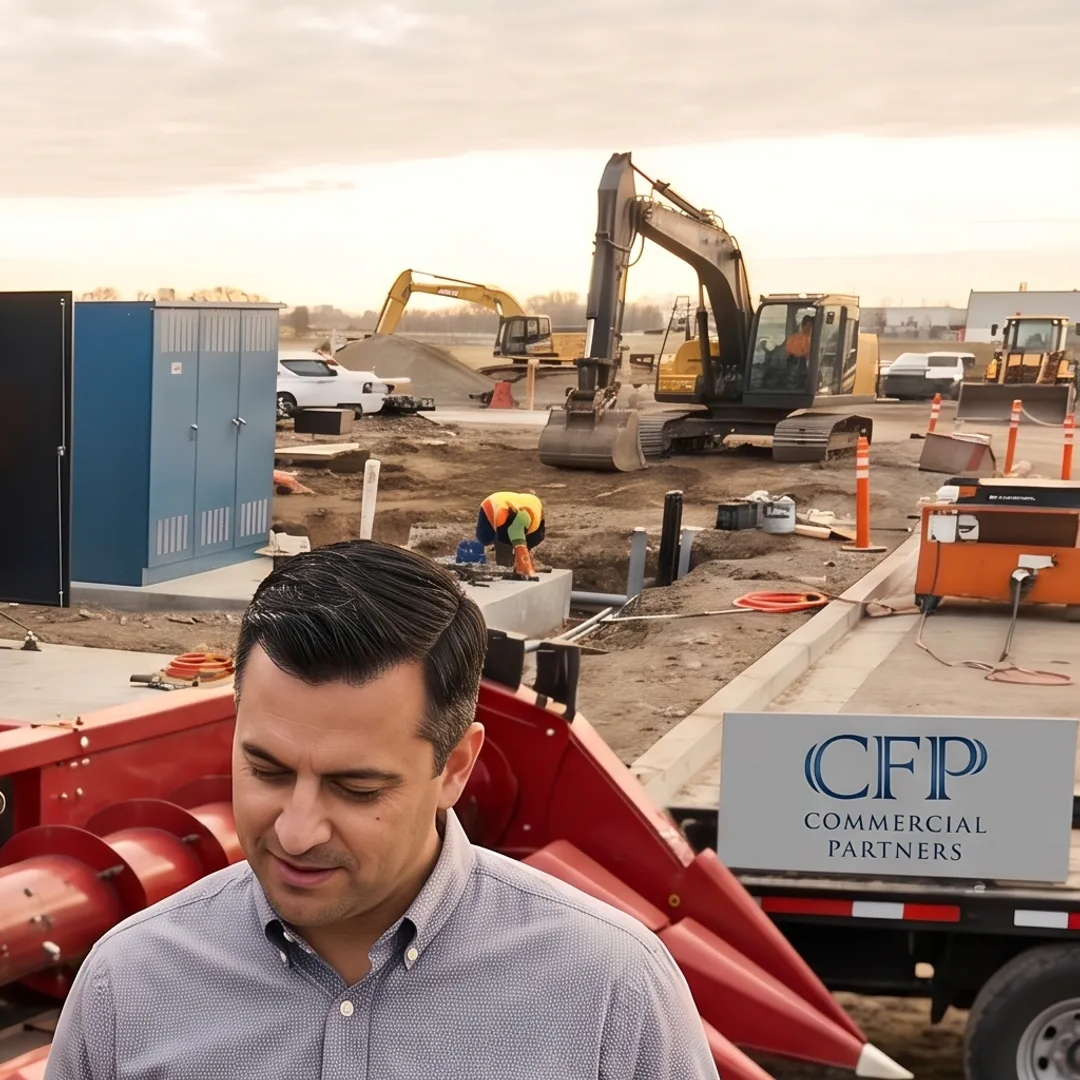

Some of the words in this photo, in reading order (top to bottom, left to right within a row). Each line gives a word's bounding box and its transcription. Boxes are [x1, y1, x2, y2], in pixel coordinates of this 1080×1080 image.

[804, 734, 988, 800] CFP
[804, 812, 987, 834] COMMERCIAL
[828, 840, 962, 861] PARTNERS
